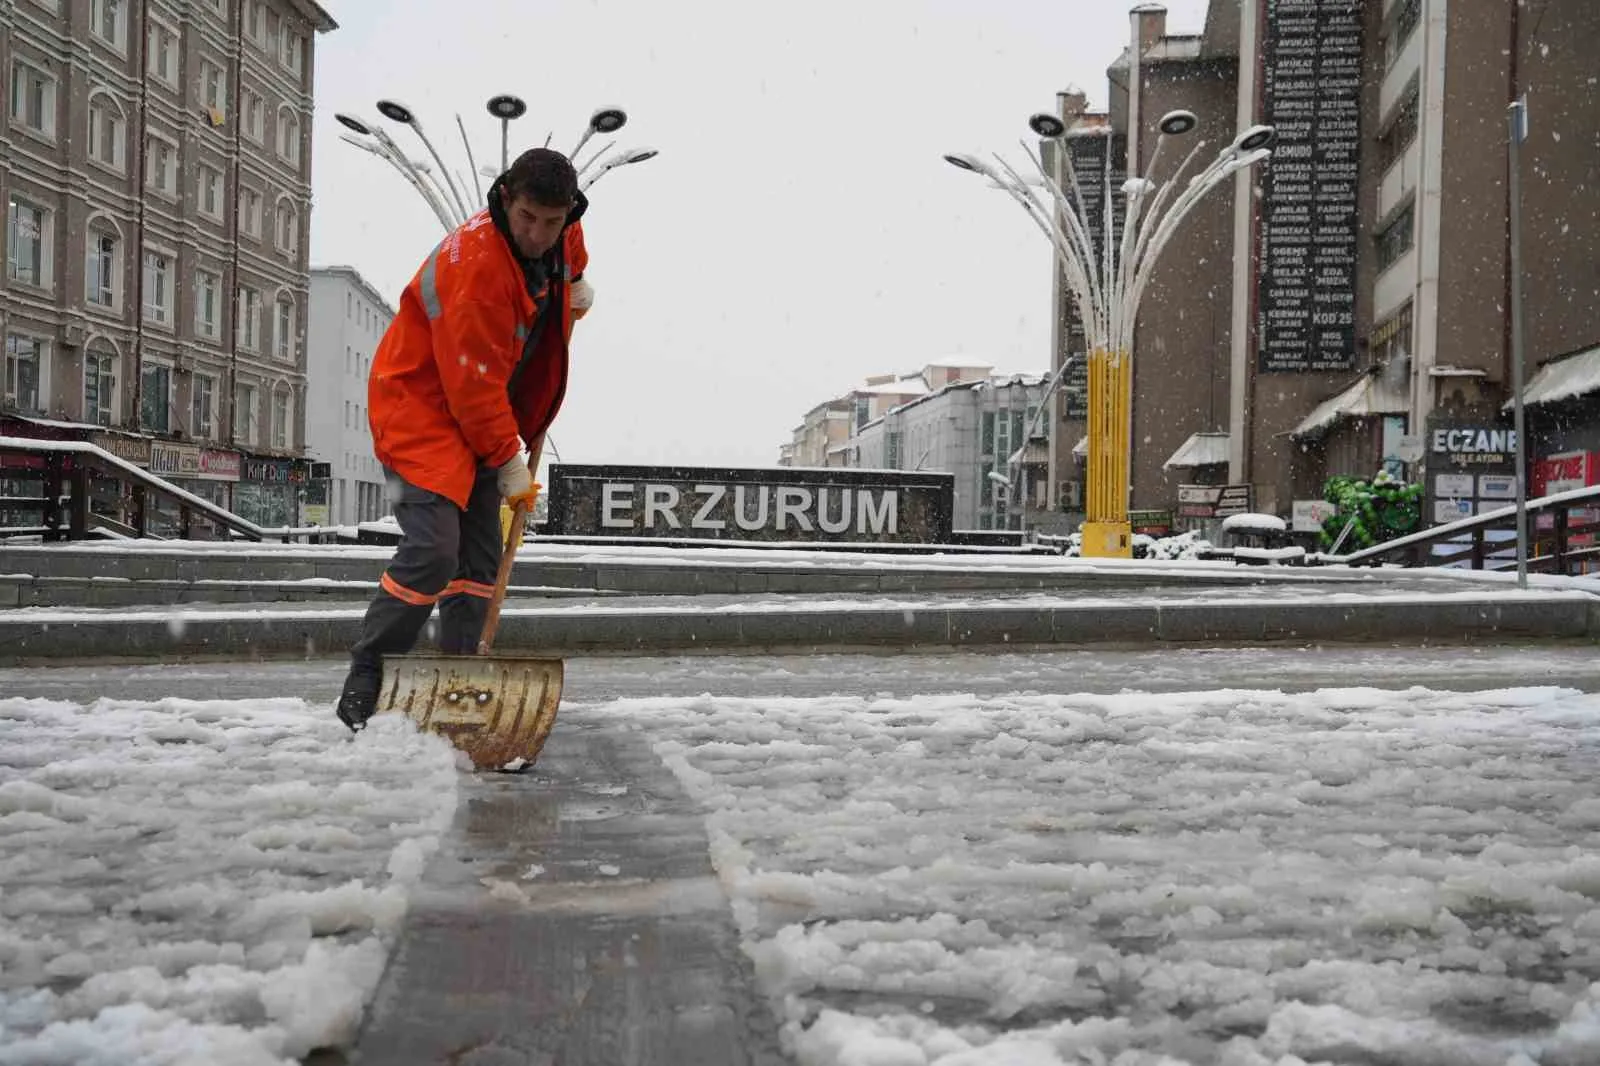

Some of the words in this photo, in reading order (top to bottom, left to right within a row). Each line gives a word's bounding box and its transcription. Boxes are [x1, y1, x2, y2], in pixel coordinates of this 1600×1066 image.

[1278, 39, 1313, 47] AVUKAT
[1278, 60, 1312, 68] AVUKAT
[1272, 268, 1306, 277] RELAX
[1313, 312, 1337, 325] KOD
[1338, 312, 1352, 325] 25
[1432, 429, 1517, 452] ECZANE
[601, 483, 899, 534] ERZURUM
